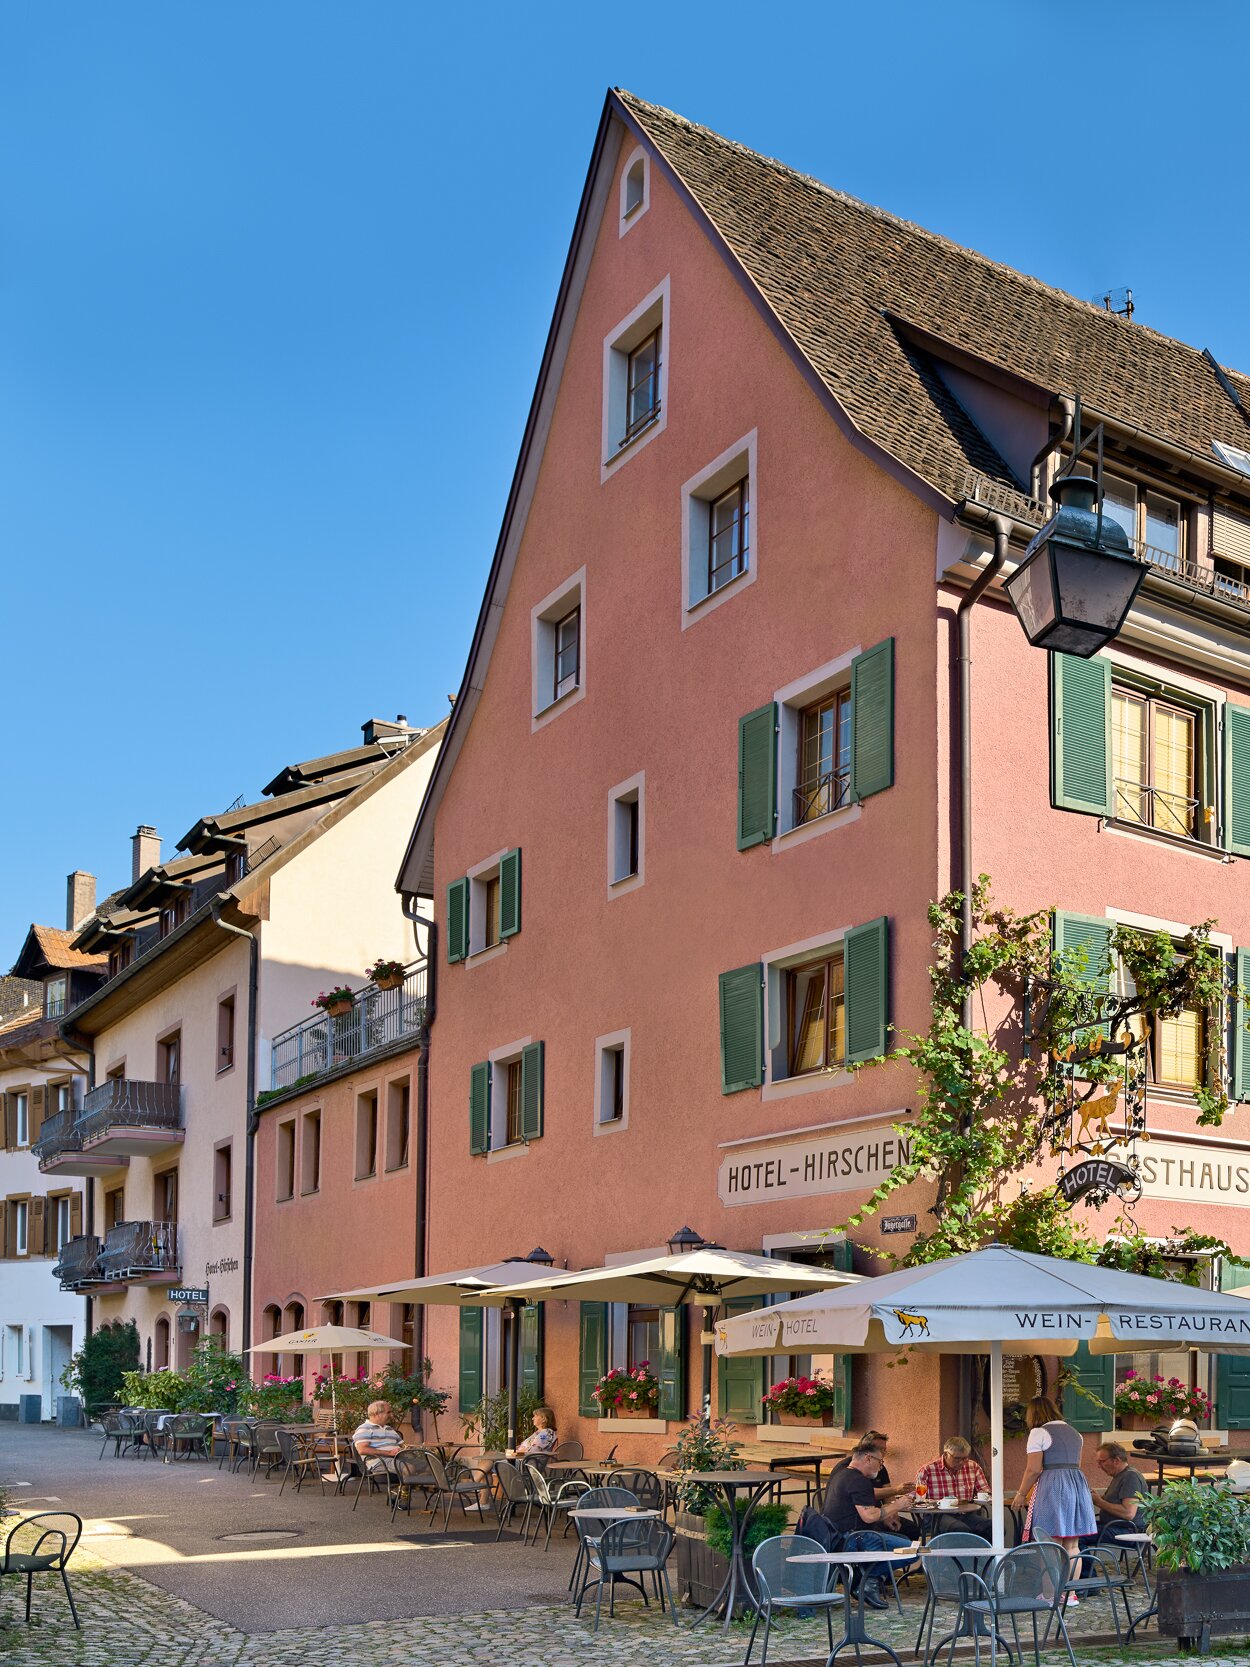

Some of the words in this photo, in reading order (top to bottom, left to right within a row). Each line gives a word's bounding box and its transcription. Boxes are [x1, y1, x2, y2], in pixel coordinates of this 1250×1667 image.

[728, 1139, 910, 1193] HOTEL-HIRSCHEN
[1063, 1162, 1117, 1195] HOTEL
[1105, 1152, 1250, 1194] STHAUS
[170, 1290, 206, 1300] HOTEL
[786, 1318, 818, 1335] HOTEL
[1015, 1313, 1091, 1328] WEIN-
